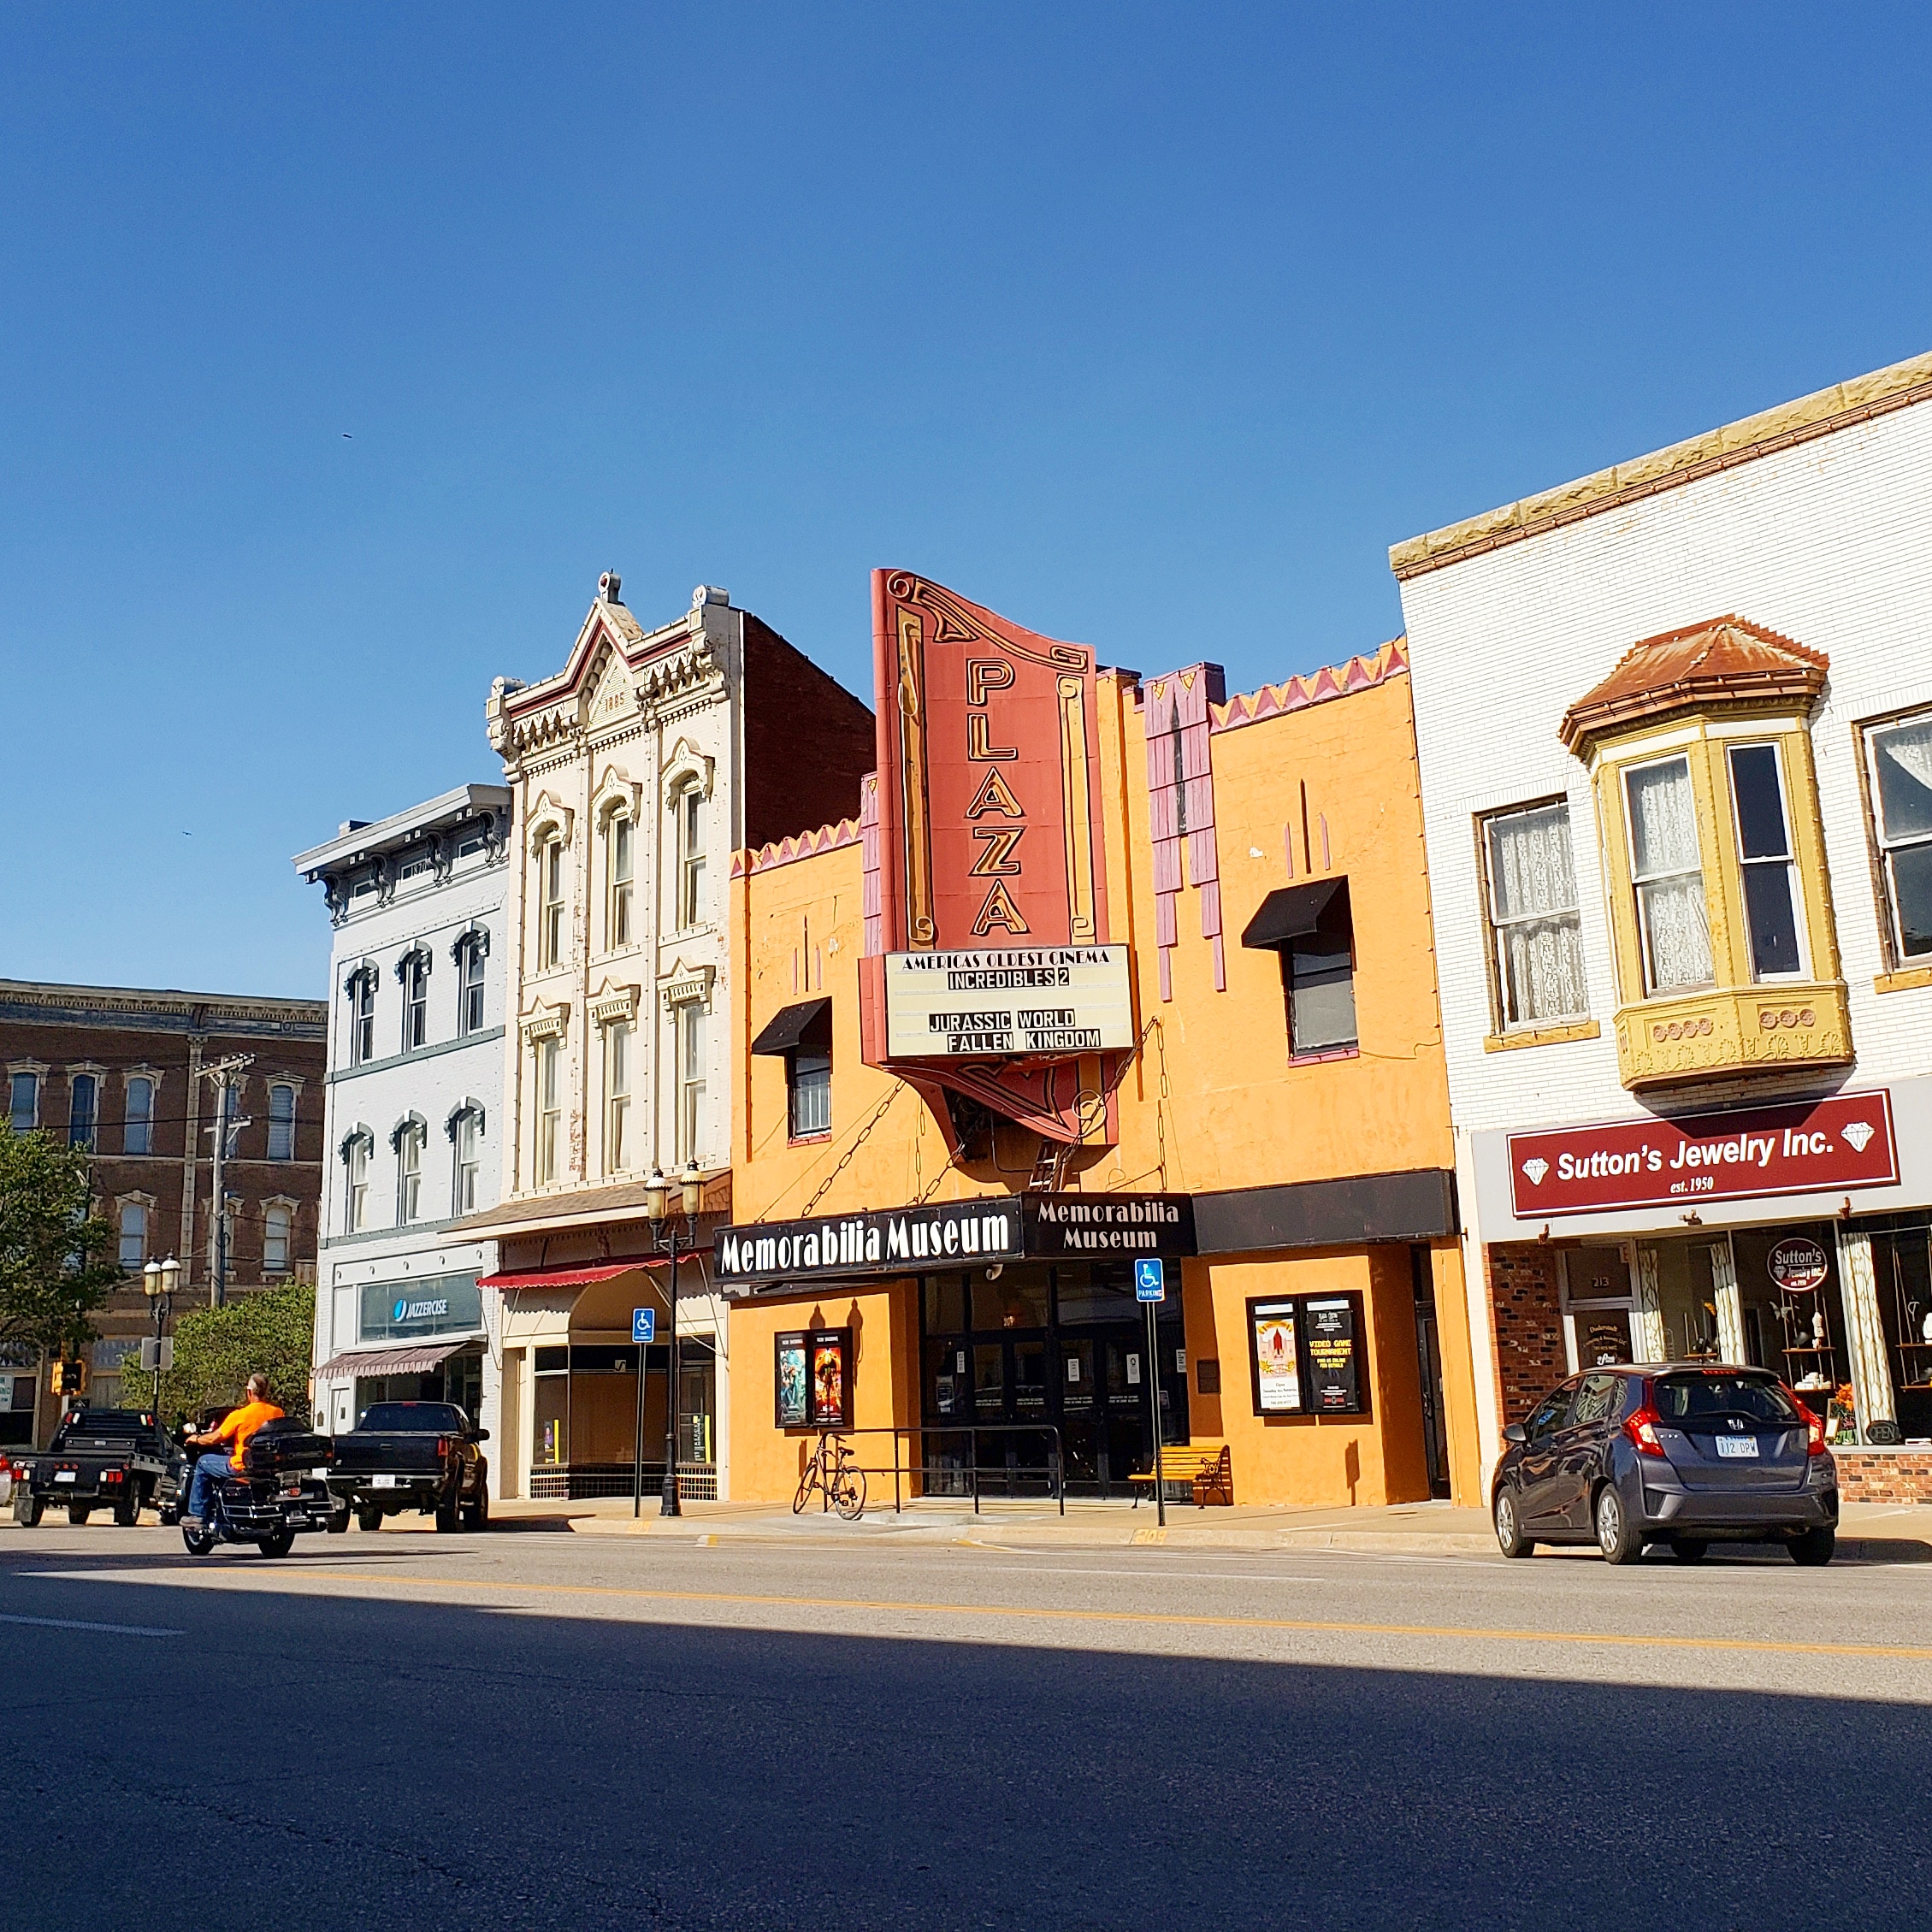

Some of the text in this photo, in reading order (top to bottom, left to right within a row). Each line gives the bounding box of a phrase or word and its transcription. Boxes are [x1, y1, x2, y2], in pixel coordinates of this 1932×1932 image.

[964, 658, 1031, 936] PLAZA
[903, 949, 1110, 971] AMERICAS OLDEST CINEMA
[949, 968, 1069, 990] INCREDIBLES 2
[930, 1009, 1075, 1031] JURASSIC WORLD
[948, 1029, 1101, 1052] FALLEN KINGDOM
[1557, 1128, 1835, 1180] Sutton's Jewelry Inc.
[1037, 1201, 1179, 1223] Memorabilia
[721, 1214, 1009, 1275] Memorabilia Museum
[1063, 1227, 1157, 1250] Museum
[1775, 1247, 1823, 1265] Sutton's
[1592, 1276, 1610, 1288] 213
[1138, 1289, 1162, 1298] PARKING
[406, 1299, 448, 1319] JAZZERCISE
[1309, 1339, 1352, 1349] VIDEO GAME
[1309, 1348, 1352, 1356] TOURNAMENT
